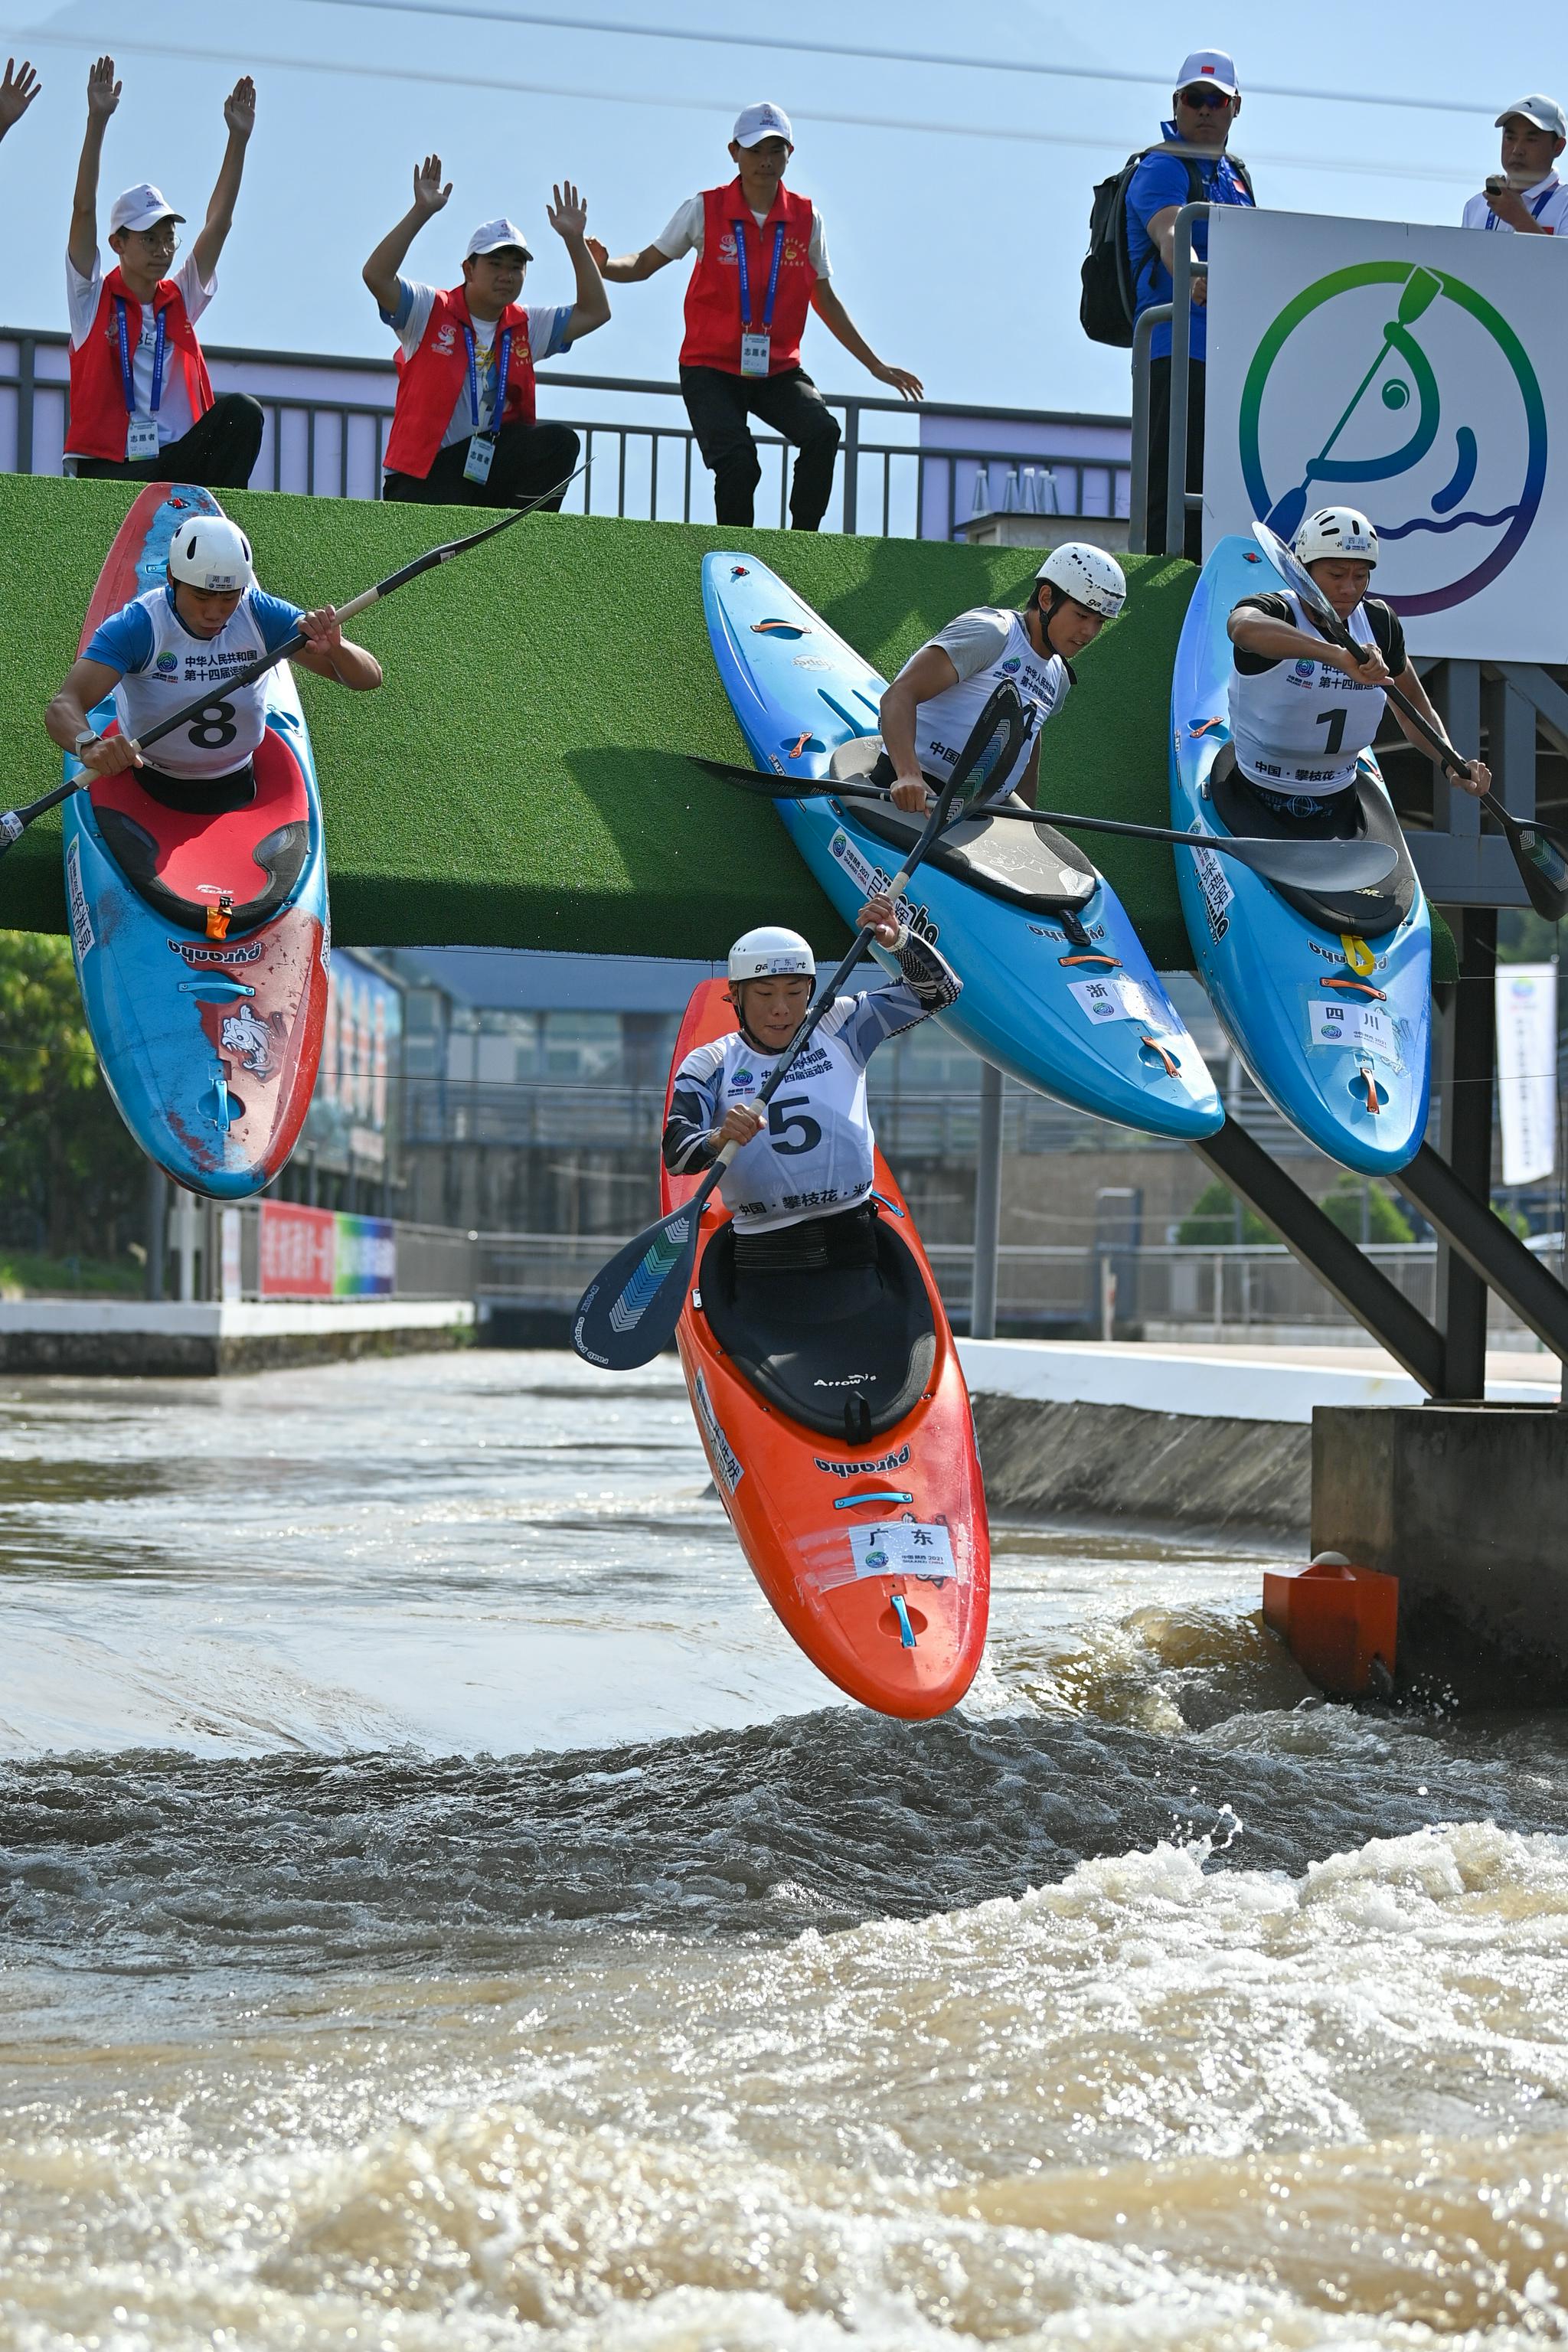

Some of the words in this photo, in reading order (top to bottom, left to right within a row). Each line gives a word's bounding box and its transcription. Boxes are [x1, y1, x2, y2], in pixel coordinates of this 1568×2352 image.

[185, 650, 257, 668] 中华人民共和国
[188, 701, 237, 749] 8
[1315, 708, 1348, 754] 1
[857, 873, 867, 886] CHINA
[858, 865, 871, 880] 2021
[1026, 924, 1106, 943] pyha
[166, 938, 262, 964] pyranha
[773, 959, 792, 967] 广东
[1307, 939, 1388, 972] pnha
[1086, 984, 1109, 998] 浙
[1325, 1007, 1379, 1031] 四川
[761, 1047, 828, 1080] 中民共和国
[761, 1060, 834, 1087] 四届运动会
[768, 1096, 822, 1155] 5
[574, 1316, 589, 1354] paddles
[587, 1351, 609, 1364] raab
[813, 1445, 910, 1478] pyranha
[870, 1528, 933, 1546] 广东
